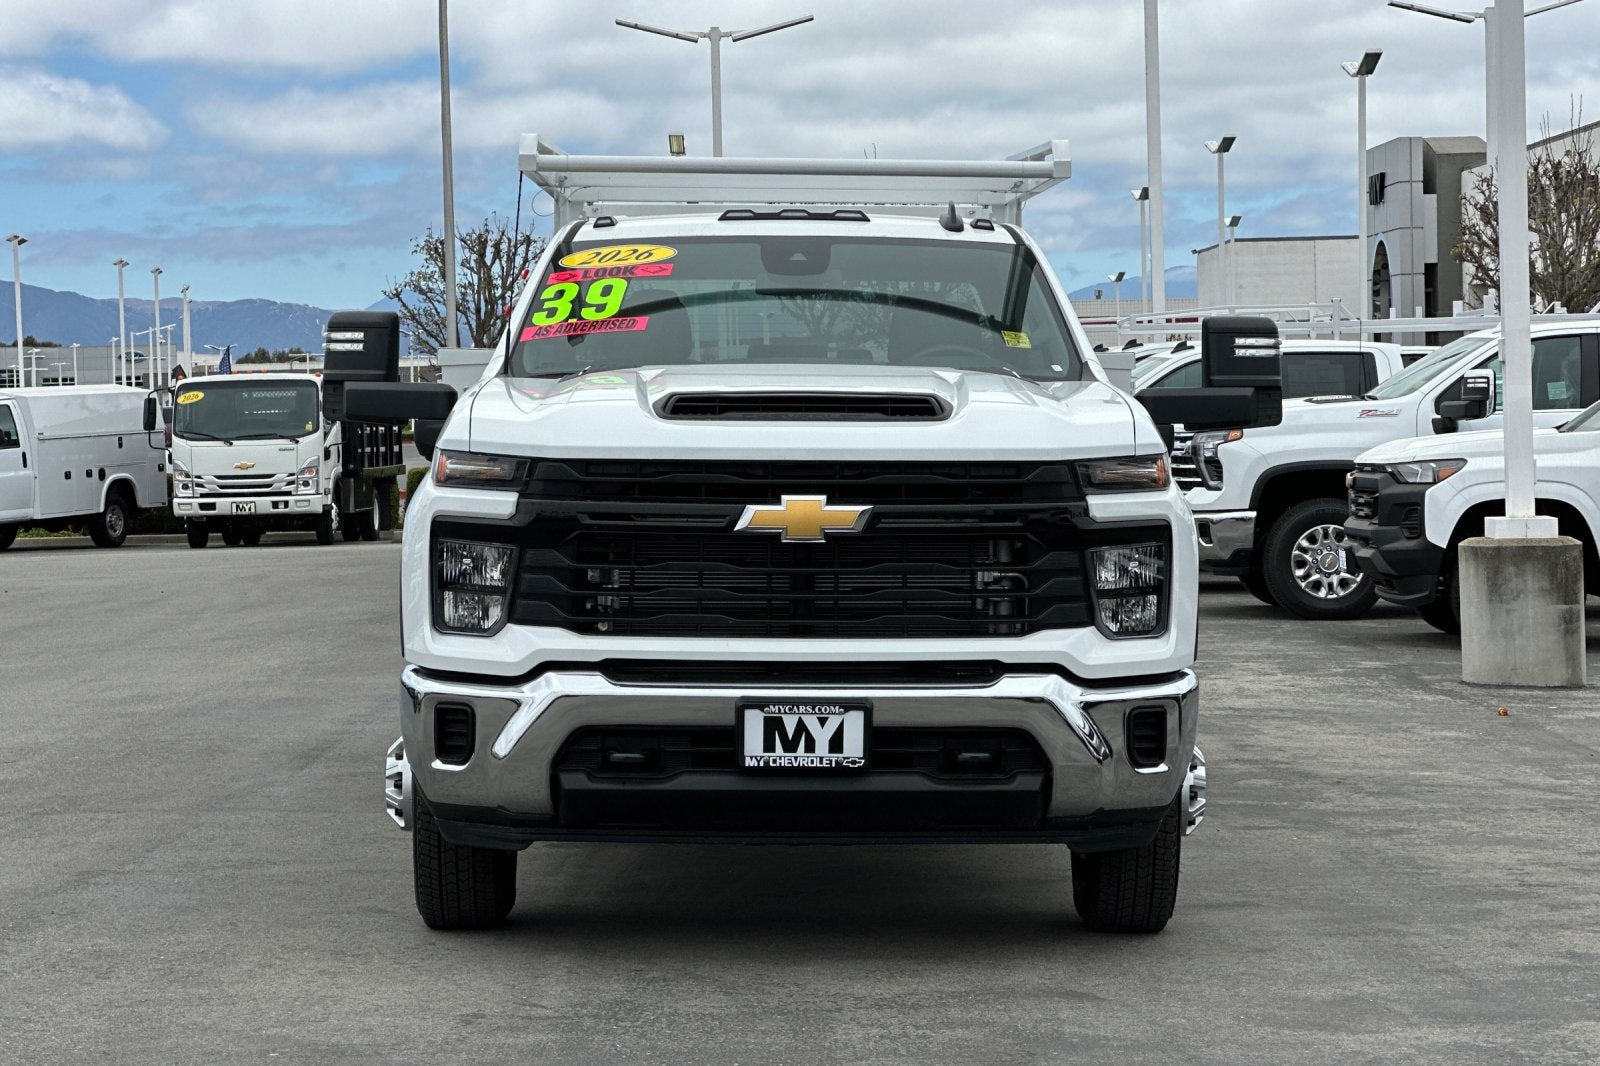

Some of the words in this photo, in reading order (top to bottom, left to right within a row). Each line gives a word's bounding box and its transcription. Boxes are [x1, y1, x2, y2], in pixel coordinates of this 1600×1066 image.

[577, 247, 660, 265] 2026
[582, 265, 636, 279] LOOK
[532, 325, 550, 337] AS
[553, 318, 638, 335] ADVERTISED
[181, 392, 199, 402] 2026
[235, 504, 252, 512] MY
[769, 705, 839, 714] MYCARS.COM
[763, 715, 844, 754] MY
[745, 756, 764, 767] MY
[769, 757, 838, 767] CHEVROLET
